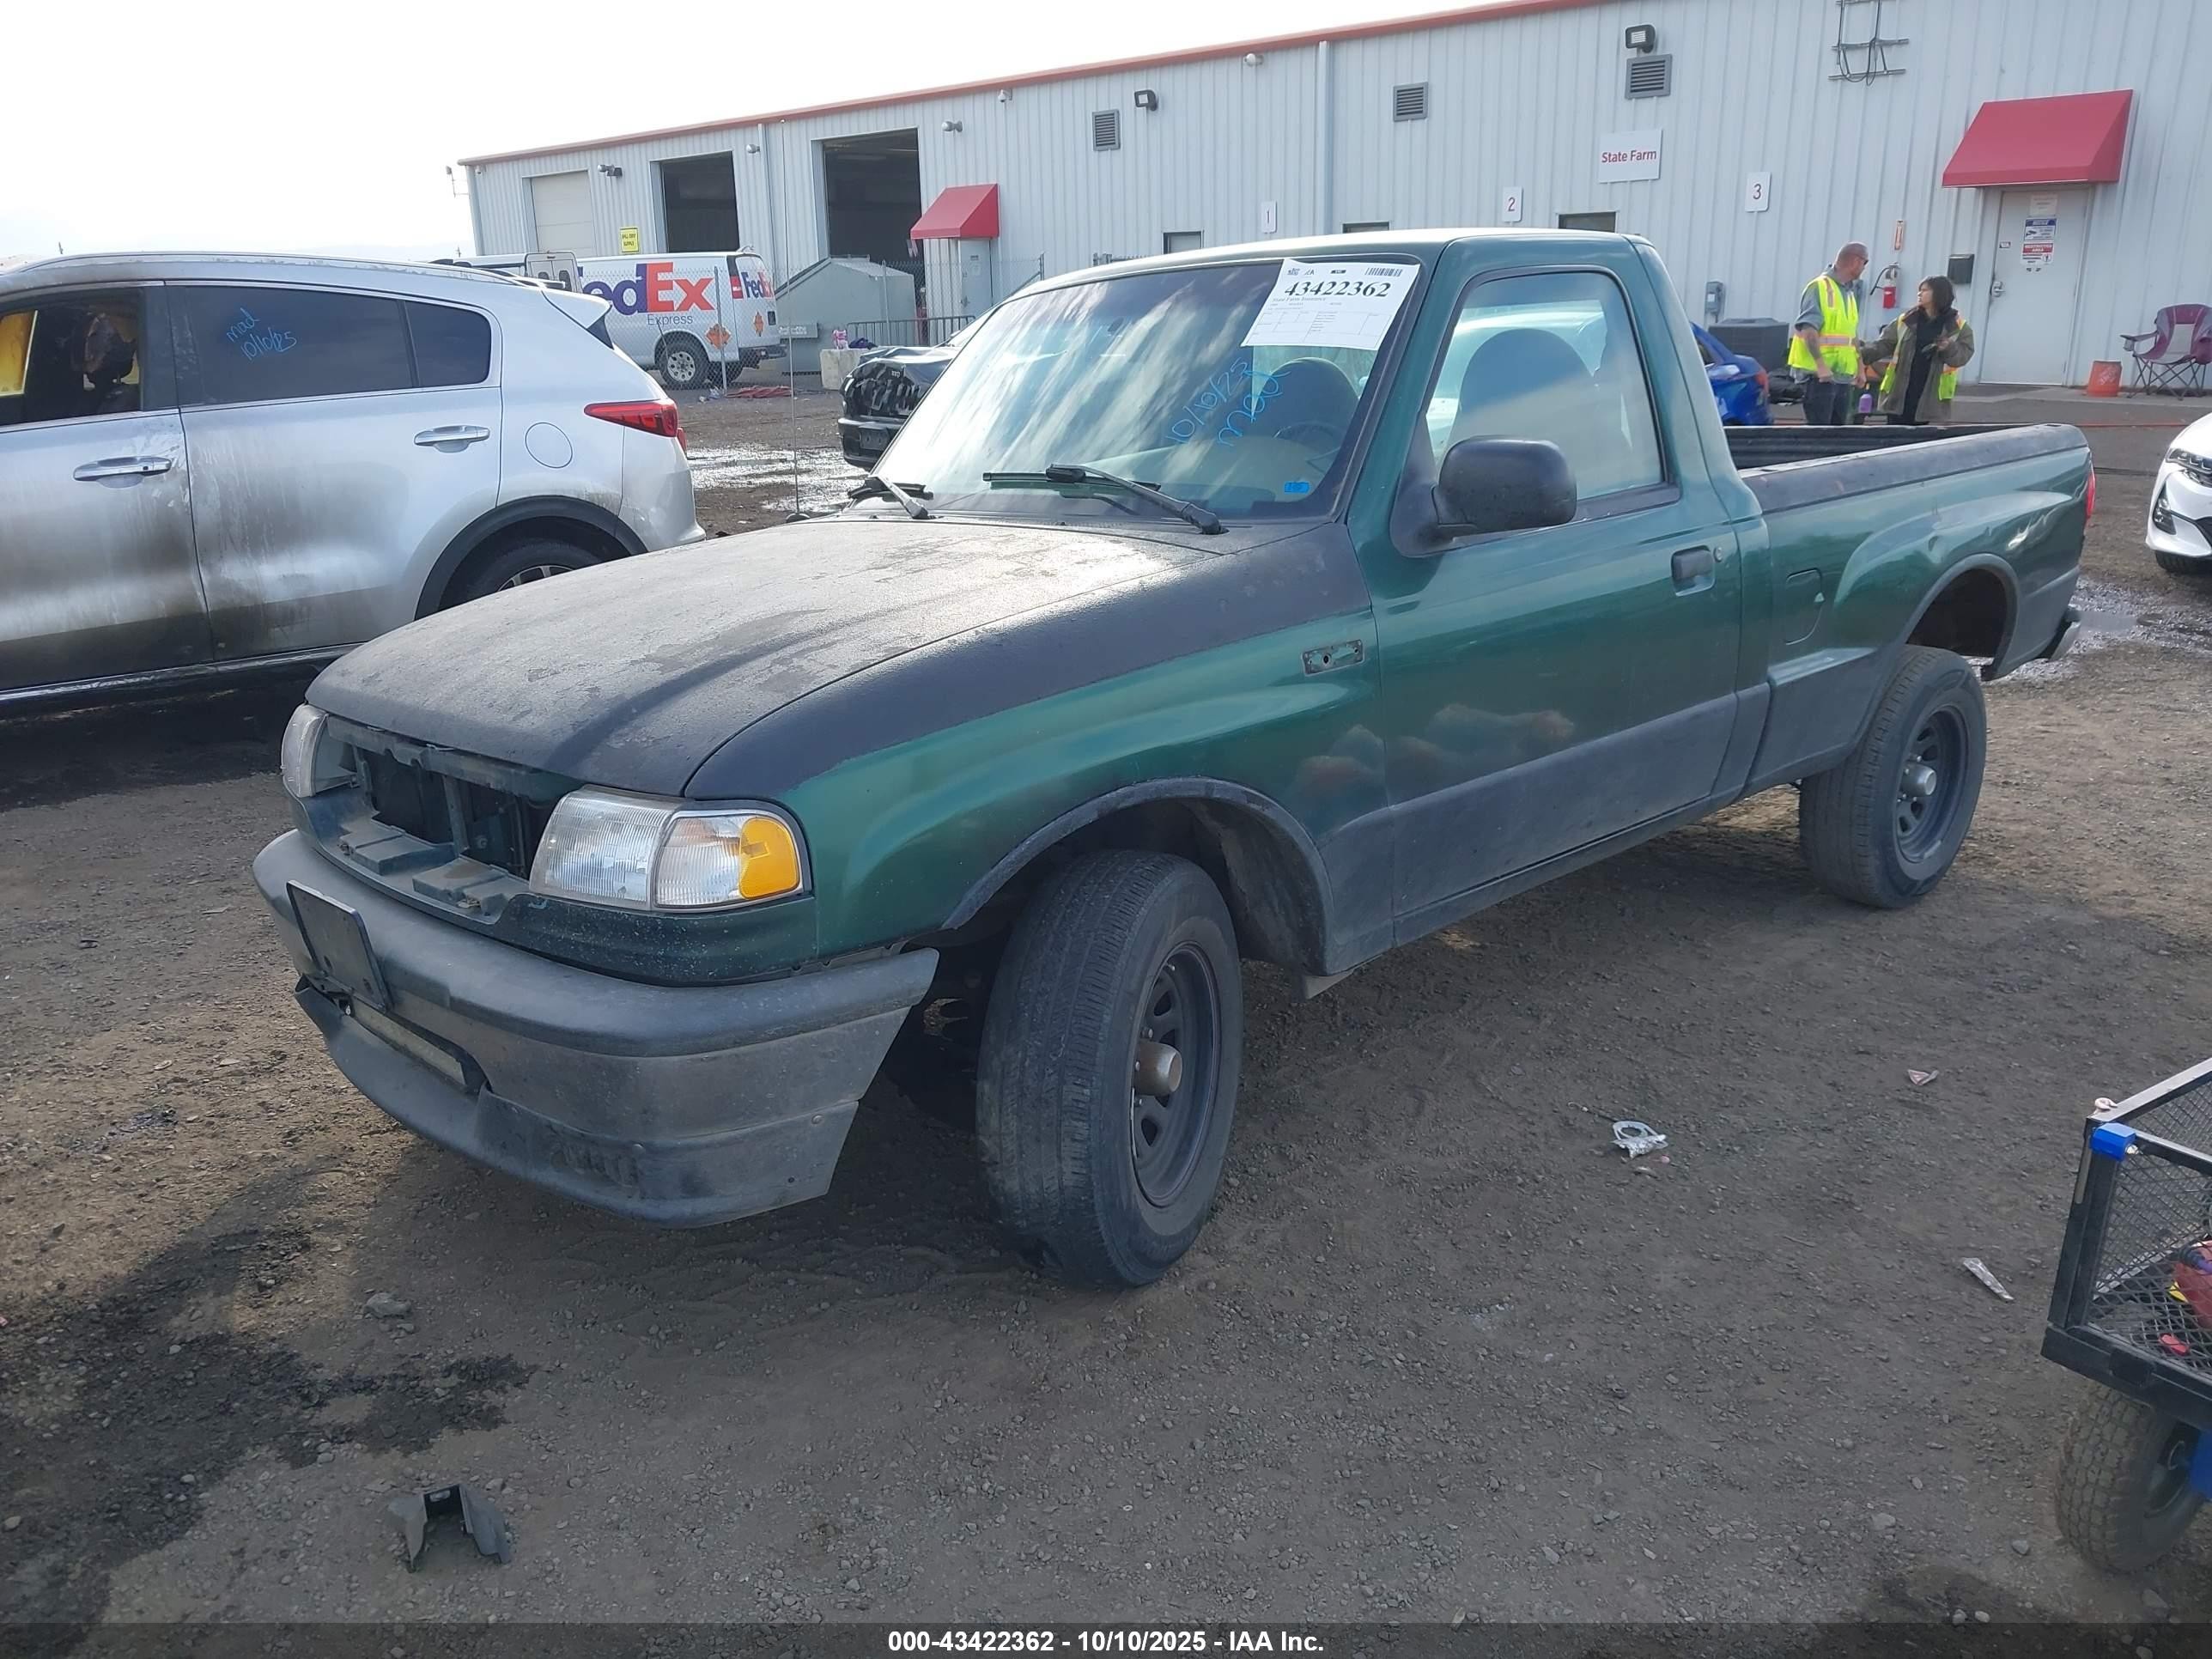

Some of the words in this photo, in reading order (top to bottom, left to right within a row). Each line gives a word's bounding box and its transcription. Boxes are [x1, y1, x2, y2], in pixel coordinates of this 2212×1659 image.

[1601, 151, 1627, 163] State
[1630, 149, 1657, 161] Farm
[1753, 184, 1762, 200] 3
[1507, 198, 1516, 211] 2
[1285, 281, 1391, 297] 43422362
[647, 314, 693, 326] Express
